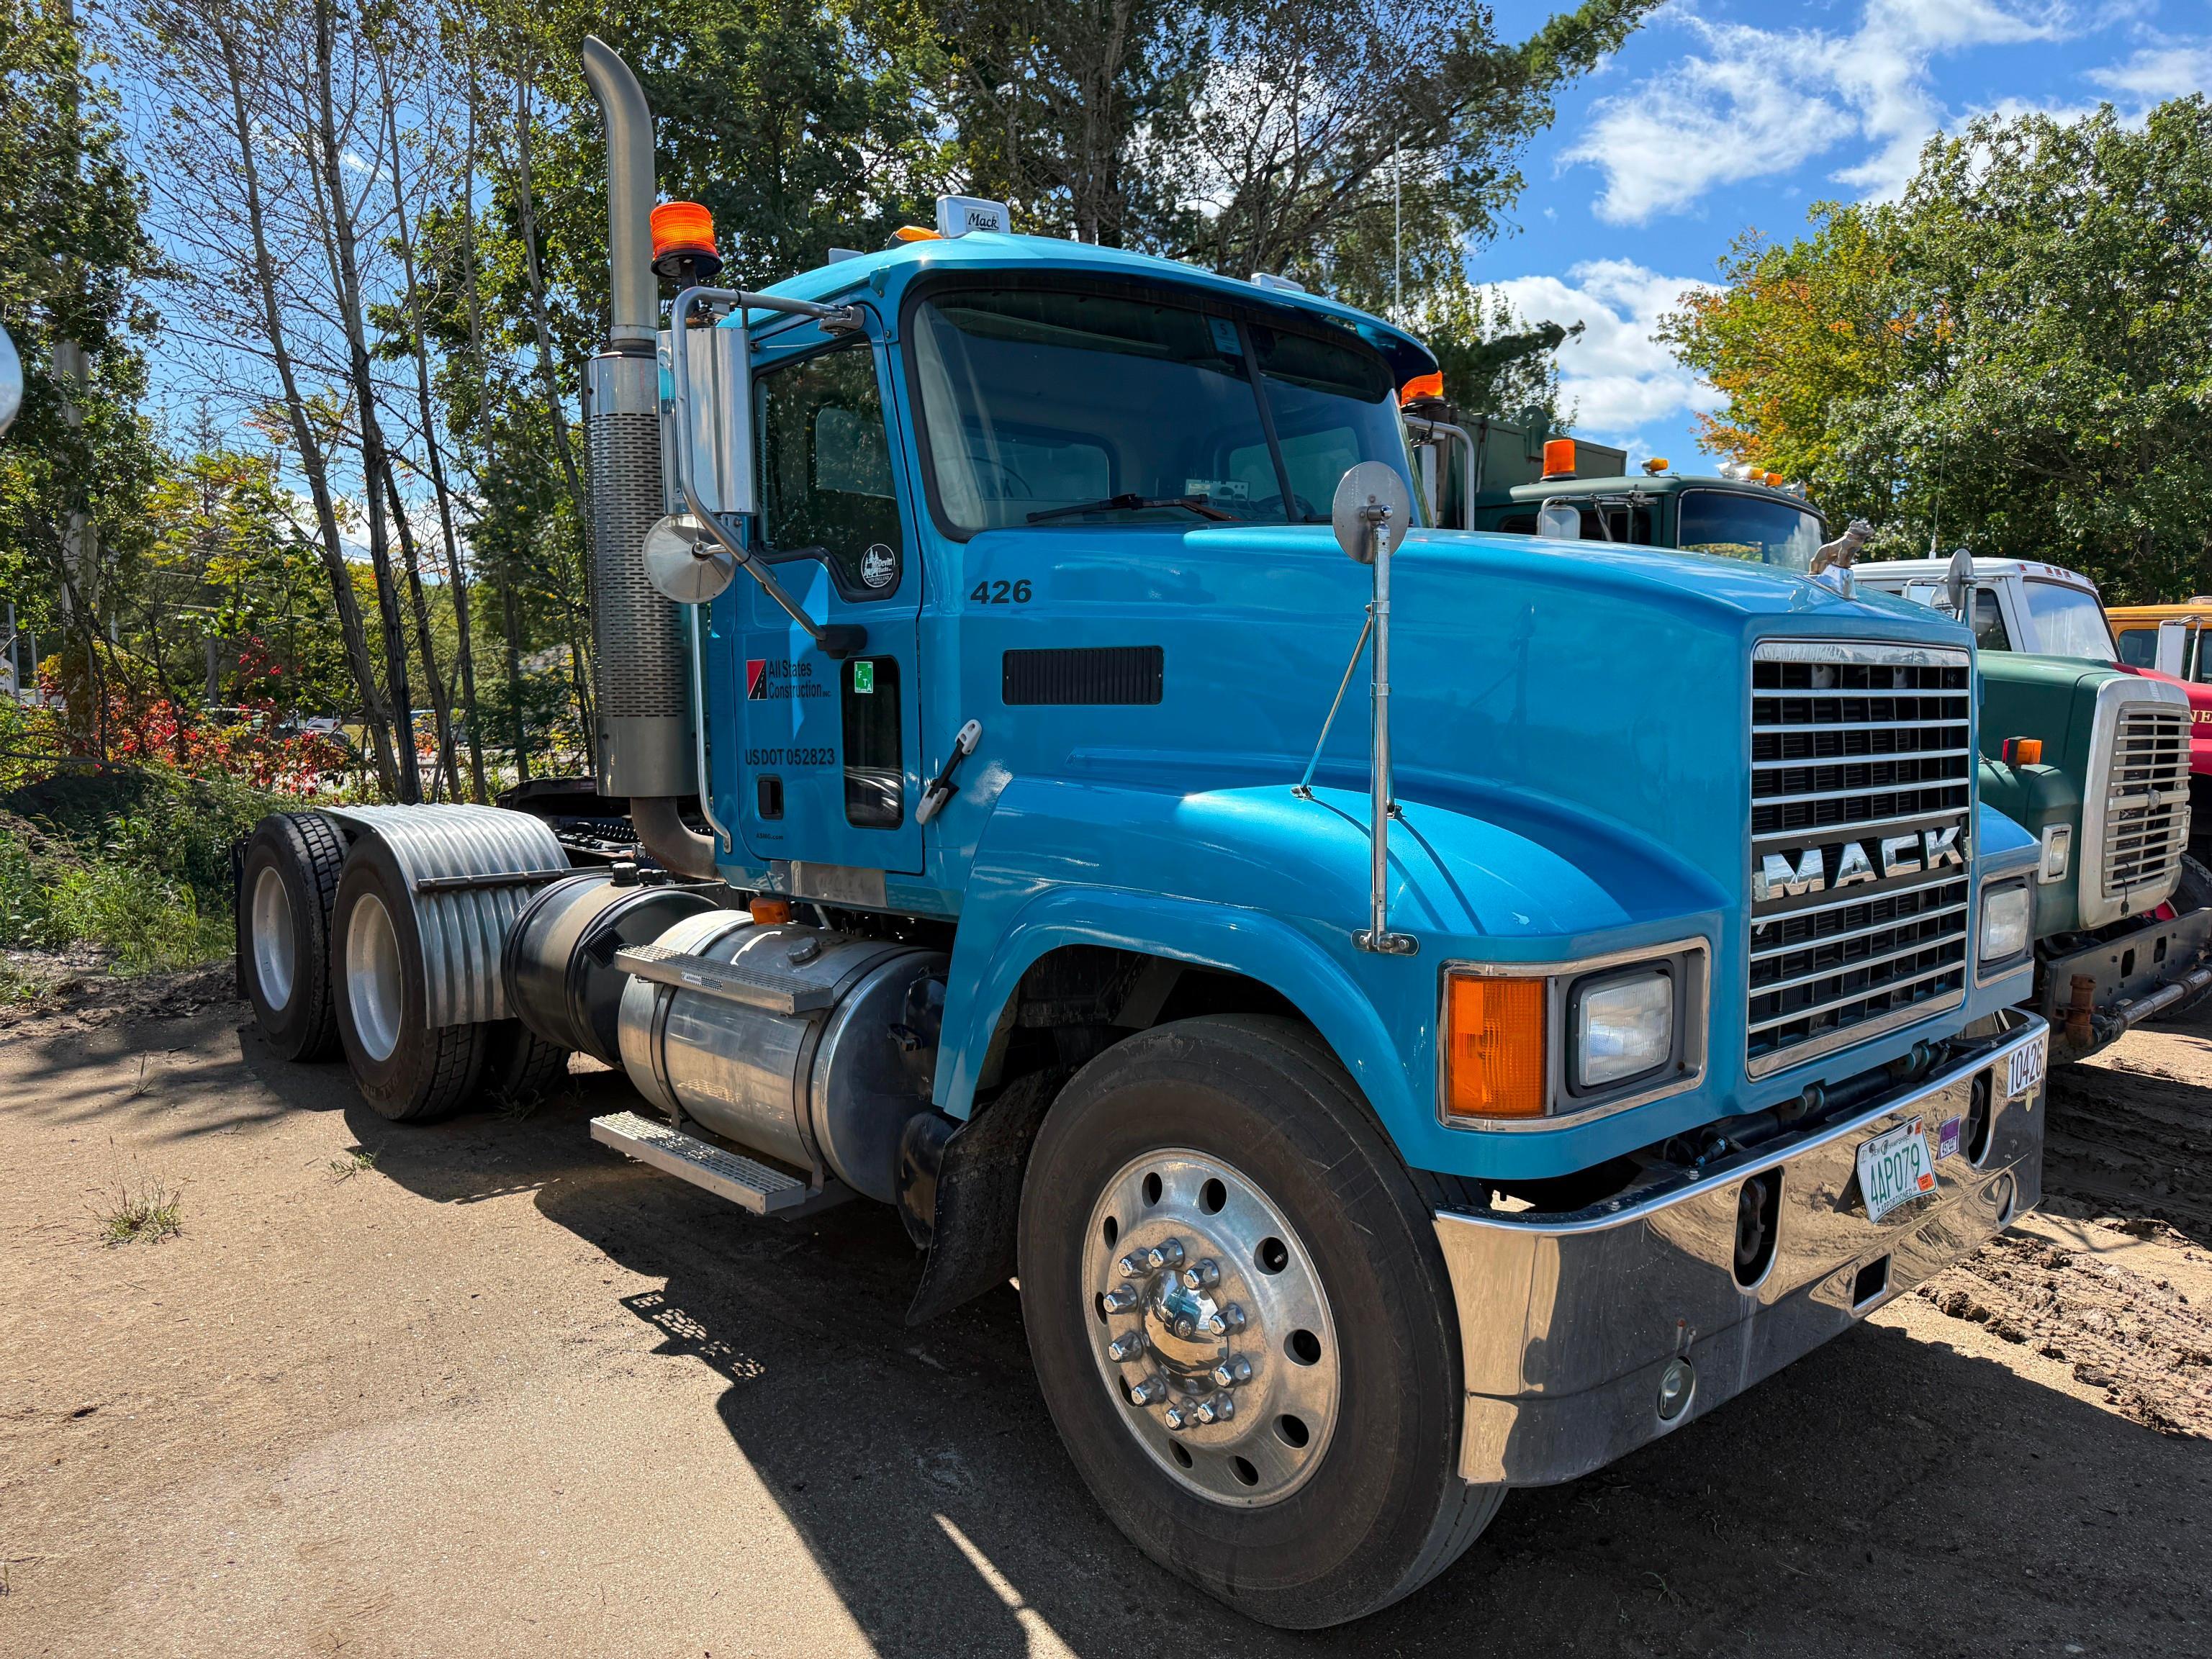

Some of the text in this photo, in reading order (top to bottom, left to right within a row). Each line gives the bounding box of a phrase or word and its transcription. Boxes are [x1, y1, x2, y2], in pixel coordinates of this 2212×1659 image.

[968, 212, 998, 230] Mack
[970, 579, 1031, 604] 426
[769, 659, 812, 678] All States
[769, 680, 821, 698] Construction
[786, 748, 835, 764] 052823
[1763, 826, 1964, 900] MACK
[2010, 1039, 2043, 1093] 10426
[1871, 1142, 1920, 1206] 4AP079
[1882, 1188, 1913, 1211] APPORTIONED
